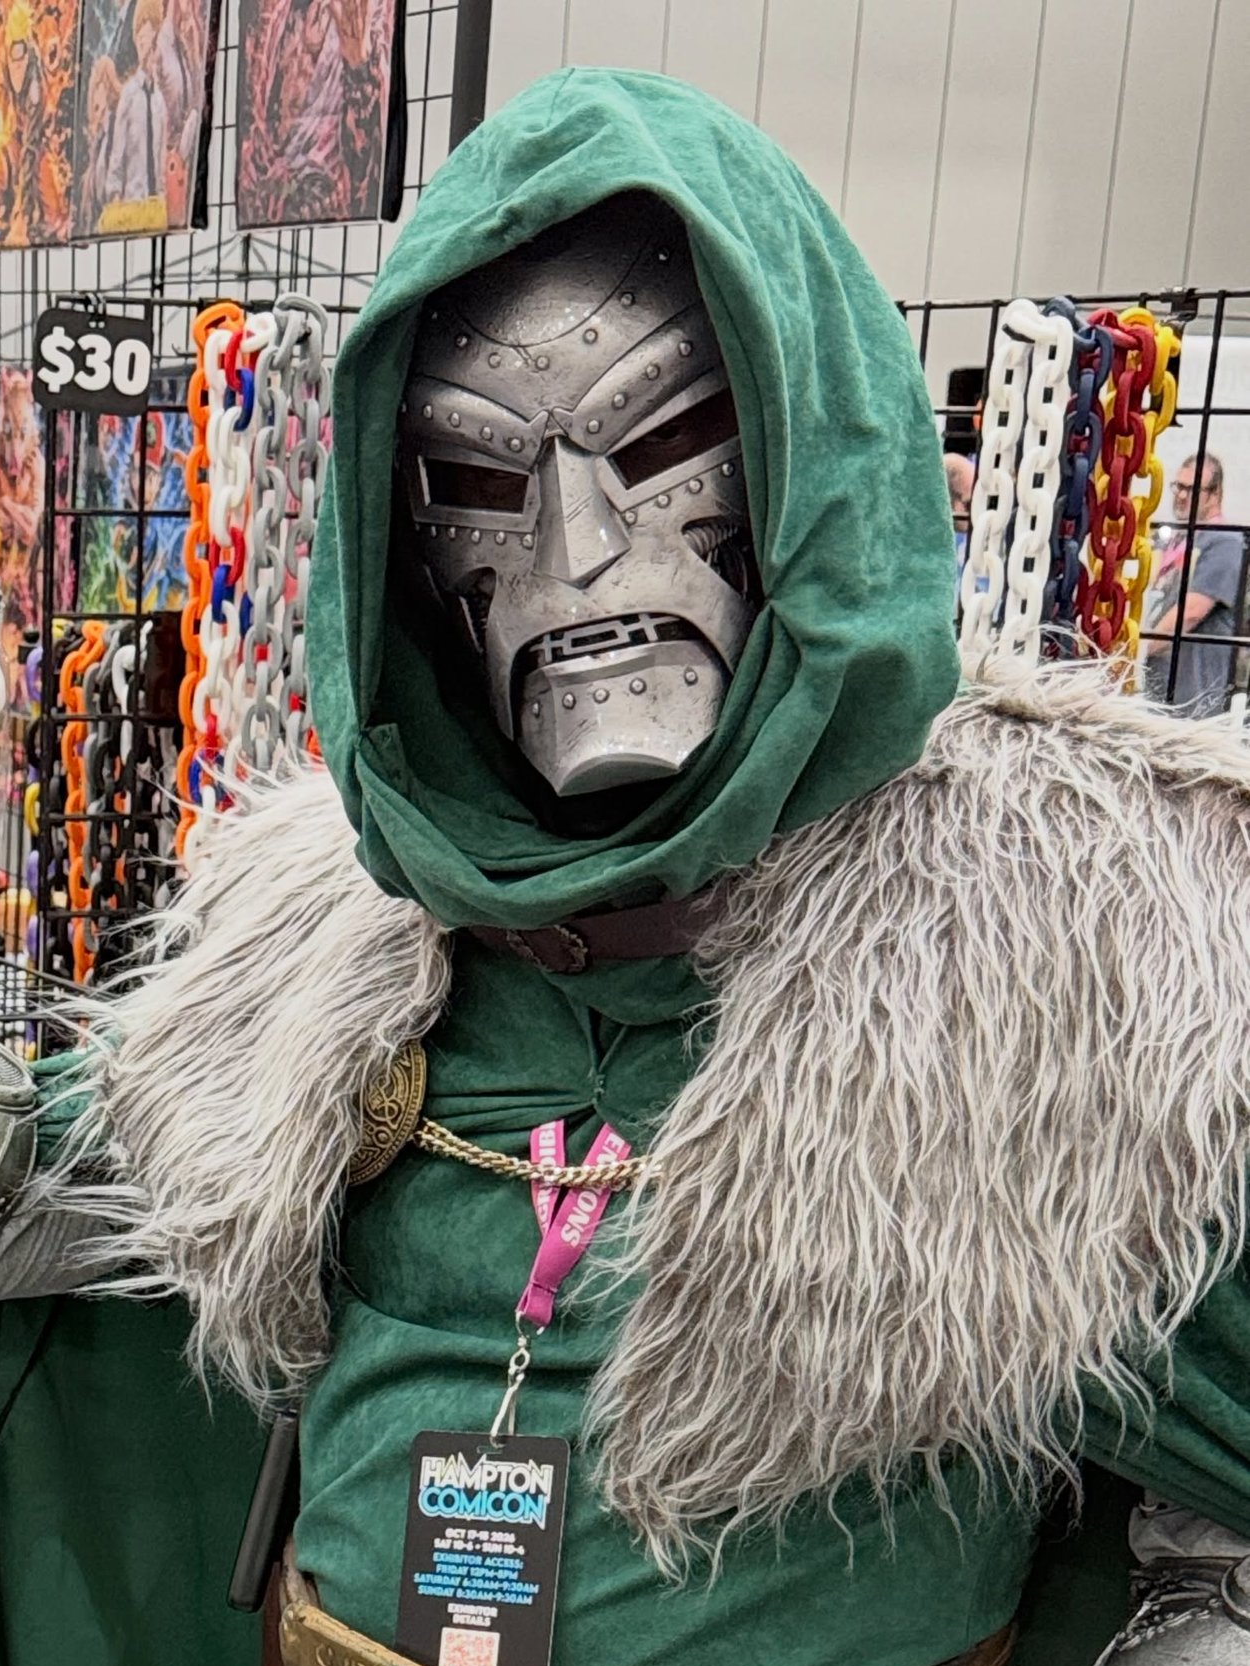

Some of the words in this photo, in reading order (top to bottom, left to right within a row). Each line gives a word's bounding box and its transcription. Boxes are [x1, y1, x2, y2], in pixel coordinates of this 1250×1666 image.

[37, 326, 151, 396] $30
[420, 1451, 554, 1498] HAMPTON
[418, 1486, 547, 1530] COMICON
[445, 1527, 467, 1540] OCT
[433, 1537, 452, 1549] SAT
[481, 1541, 503, 1553] SUN
[433, 1551, 483, 1566] EXHIBITOR
[483, 1556, 524, 1570] ACCESS:
[436, 1563, 470, 1576] FRIDAY
[413, 1572, 461, 1587] SATURDAY
[417, 1584, 456, 1597] SUNDAY
[447, 1602, 498, 1618] EXHIBITOR
[452, 1613, 492, 1627] DETAILS
